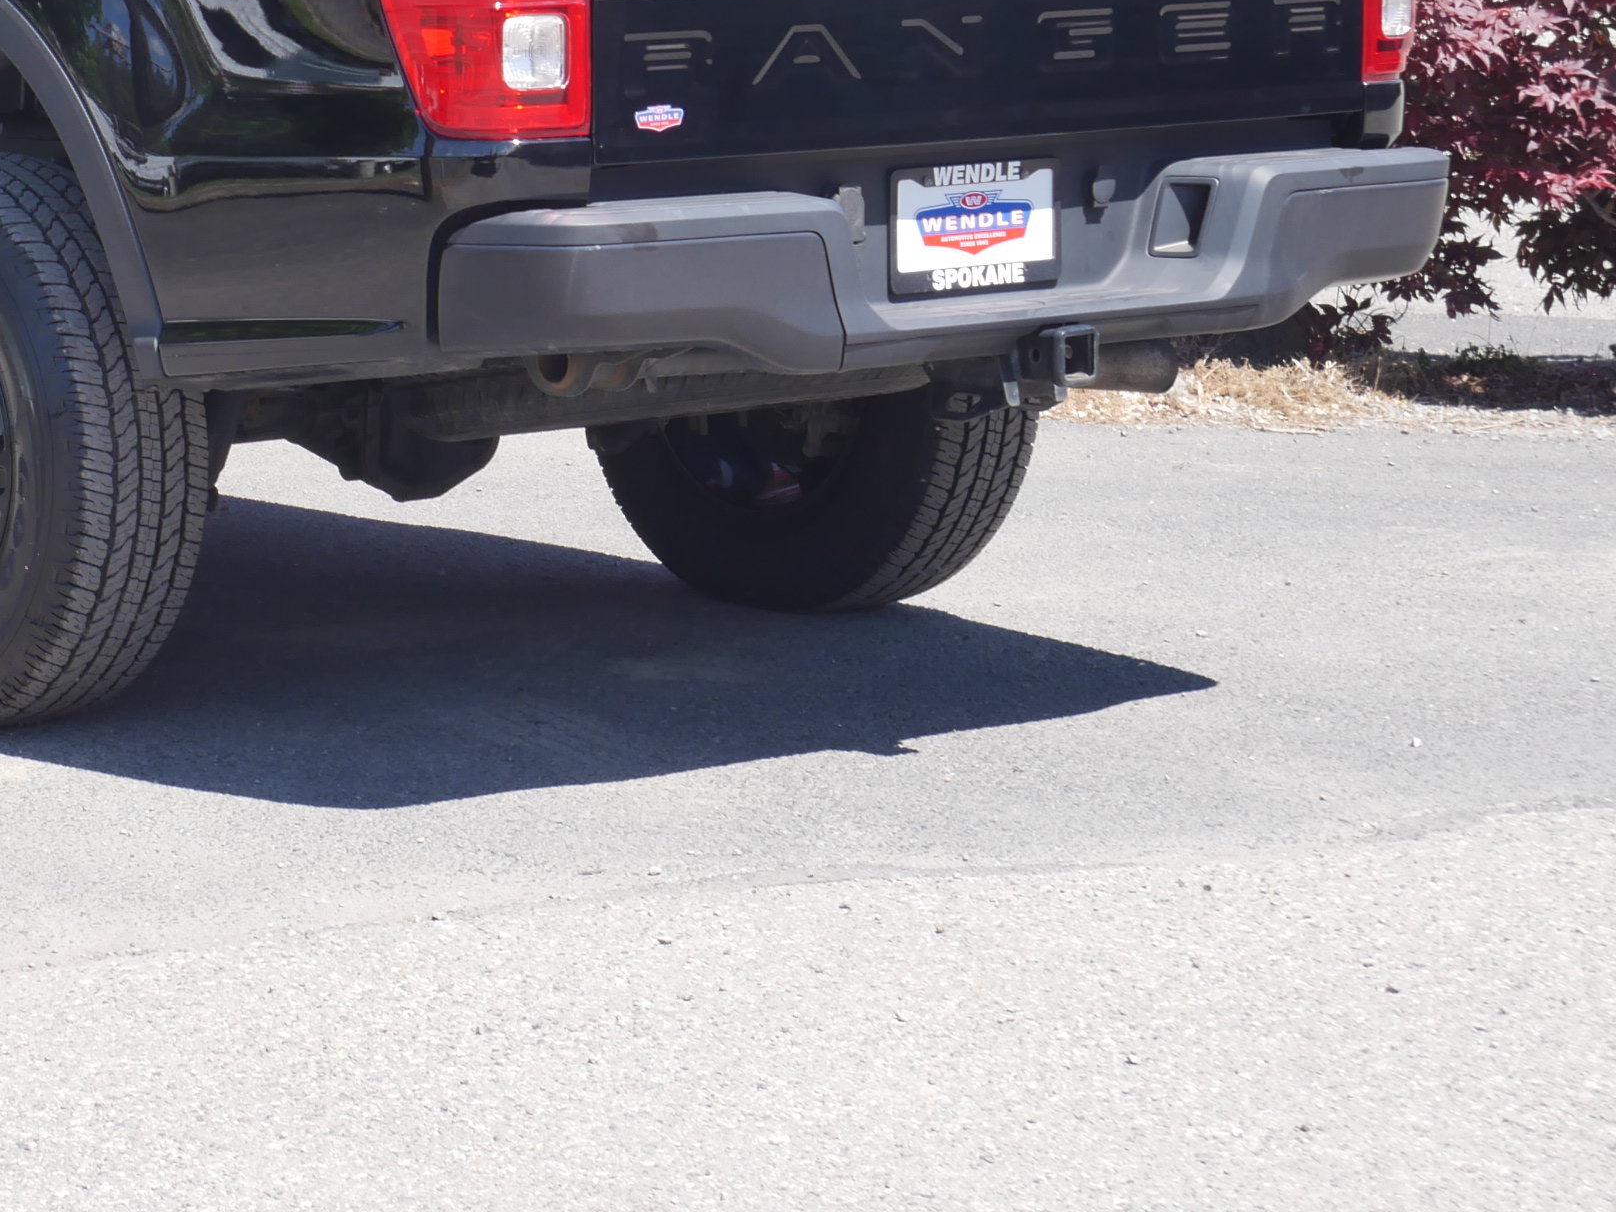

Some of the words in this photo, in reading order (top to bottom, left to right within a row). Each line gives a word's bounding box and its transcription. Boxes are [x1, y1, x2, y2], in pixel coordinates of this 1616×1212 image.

[638, 112, 680, 123] WENDLE
[933, 160, 1021, 187] WENDLE
[922, 210, 1024, 233] WENDLE
[931, 262, 1026, 291] SPOKANE
